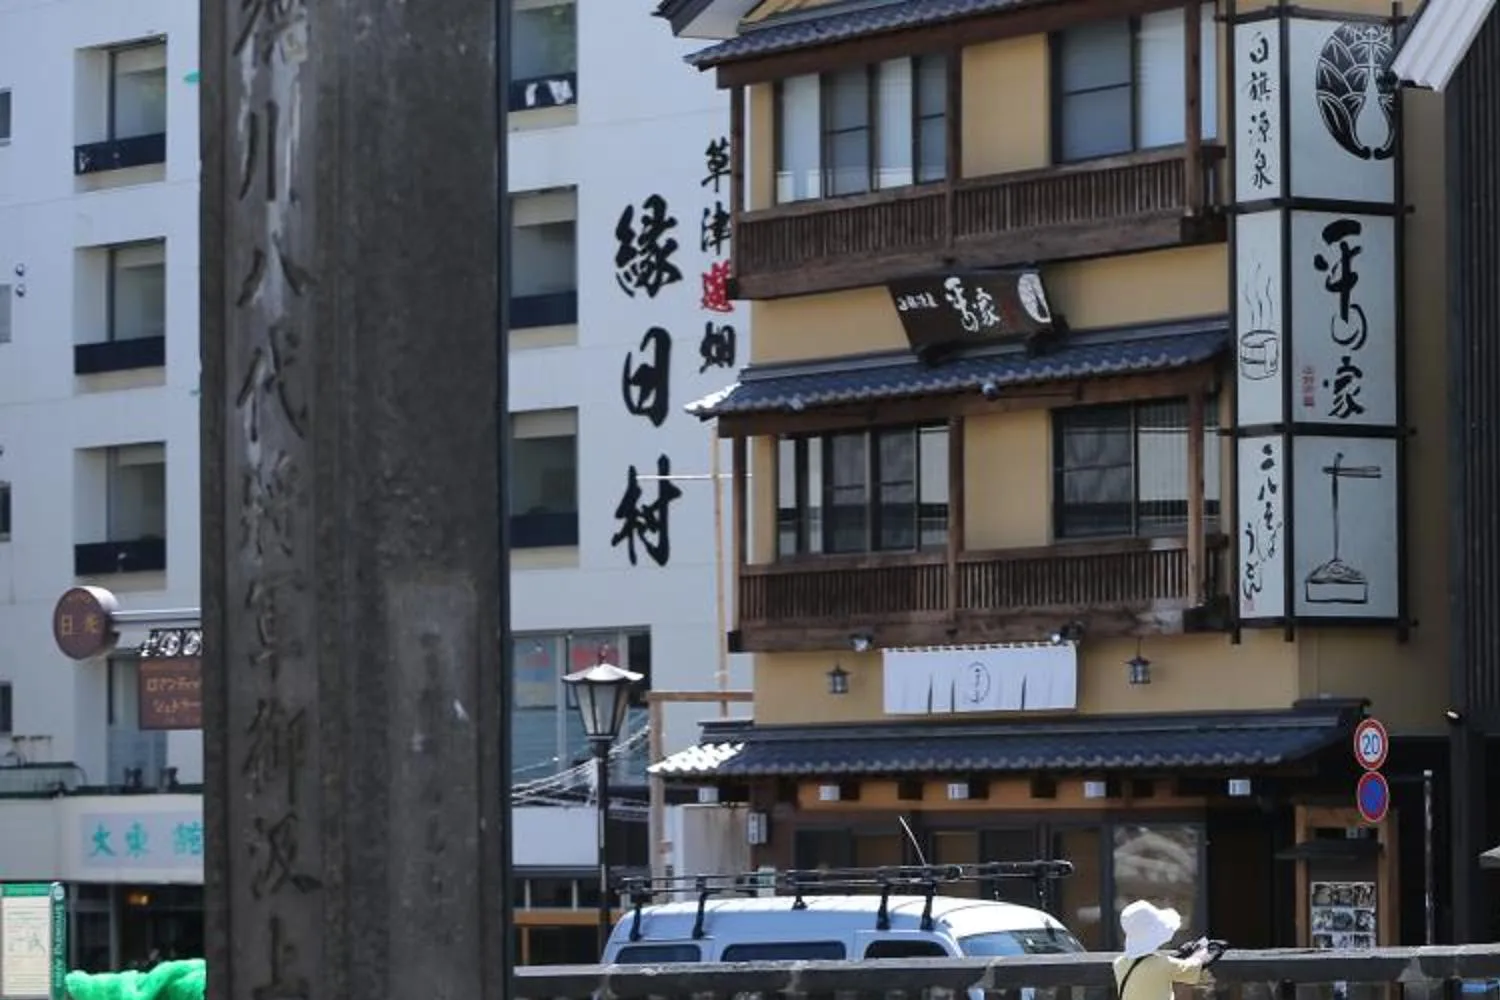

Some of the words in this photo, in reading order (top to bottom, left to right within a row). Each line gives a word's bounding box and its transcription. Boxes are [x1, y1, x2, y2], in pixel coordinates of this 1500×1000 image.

[613, 193, 684, 567] 縁日村
[1362, 734, 1380, 755] 20
